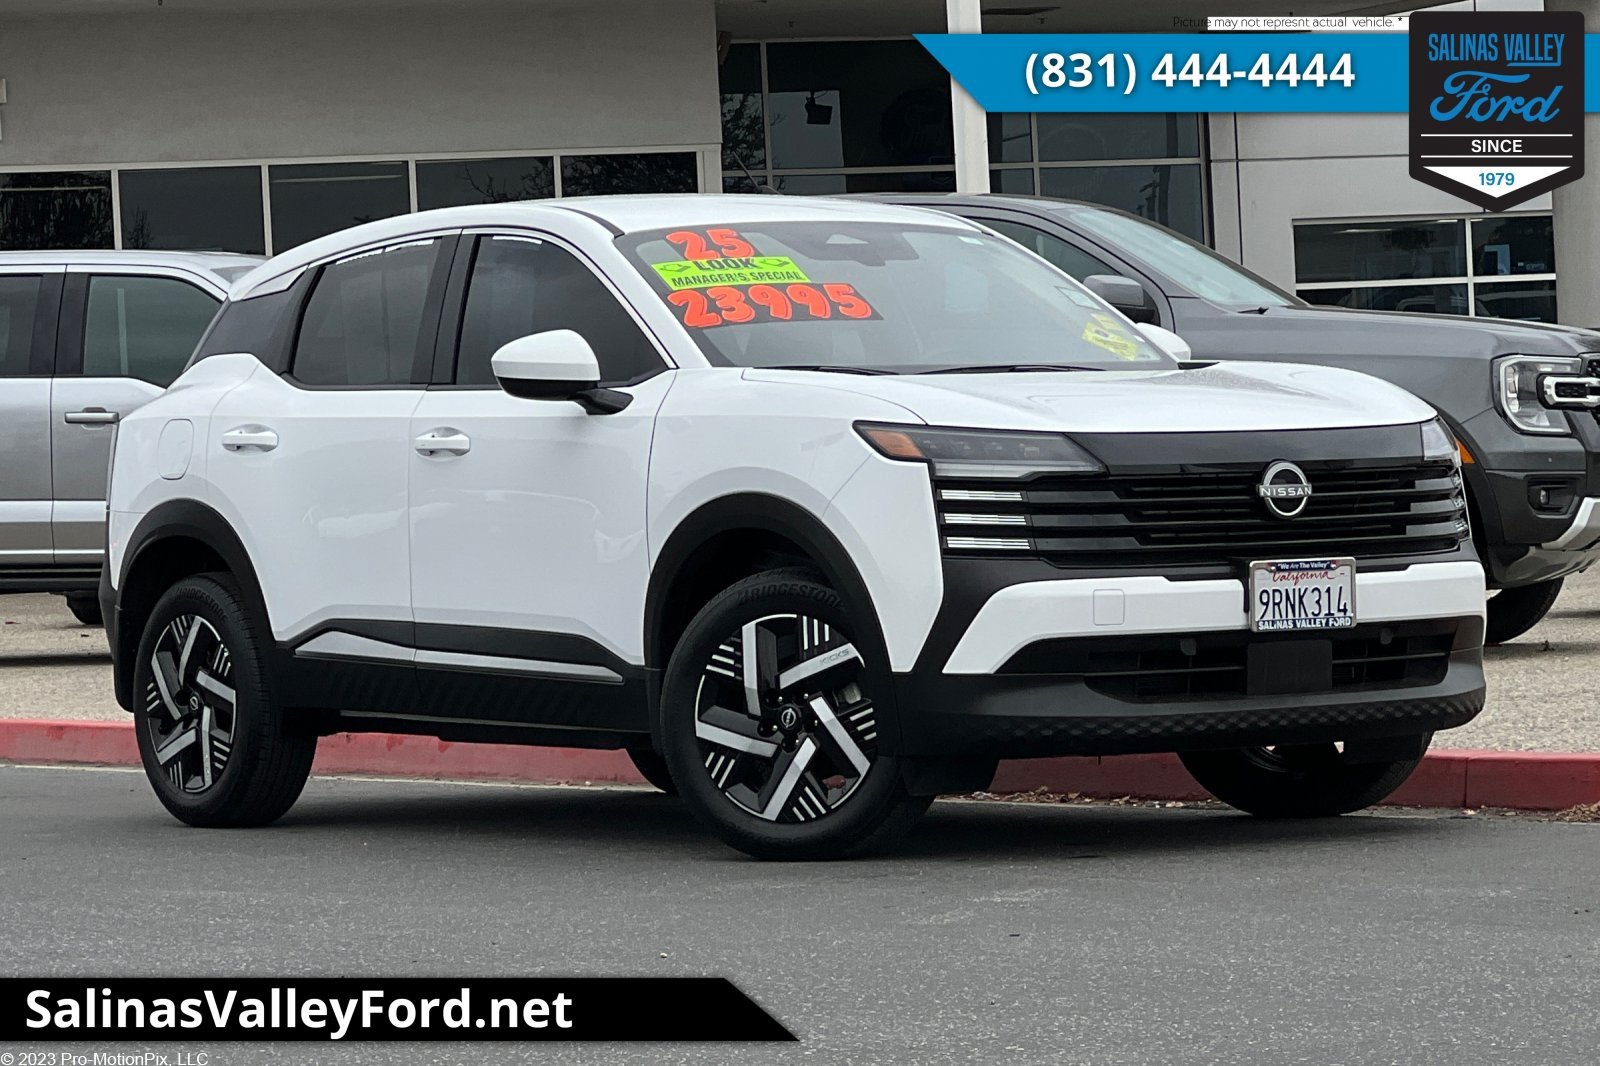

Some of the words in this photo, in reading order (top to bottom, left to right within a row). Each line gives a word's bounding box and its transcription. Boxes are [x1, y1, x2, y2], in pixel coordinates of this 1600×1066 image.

[665, 228, 756, 261] 25
[692, 258, 758, 271] LOOK
[671, 271, 749, 287] MANAGER'S
[750, 270, 804, 283] SPECIAL
[667, 282, 872, 328] 23995
[1260, 486, 1312, 497] NISSAN
[1272, 570, 1337, 586] California
[1259, 585, 1349, 620] 9RNK314
[1258, 620, 1294, 631] SALINAS
[1295, 618, 1328, 629] VALLEY
[1328, 617, 1351, 627] FORD
